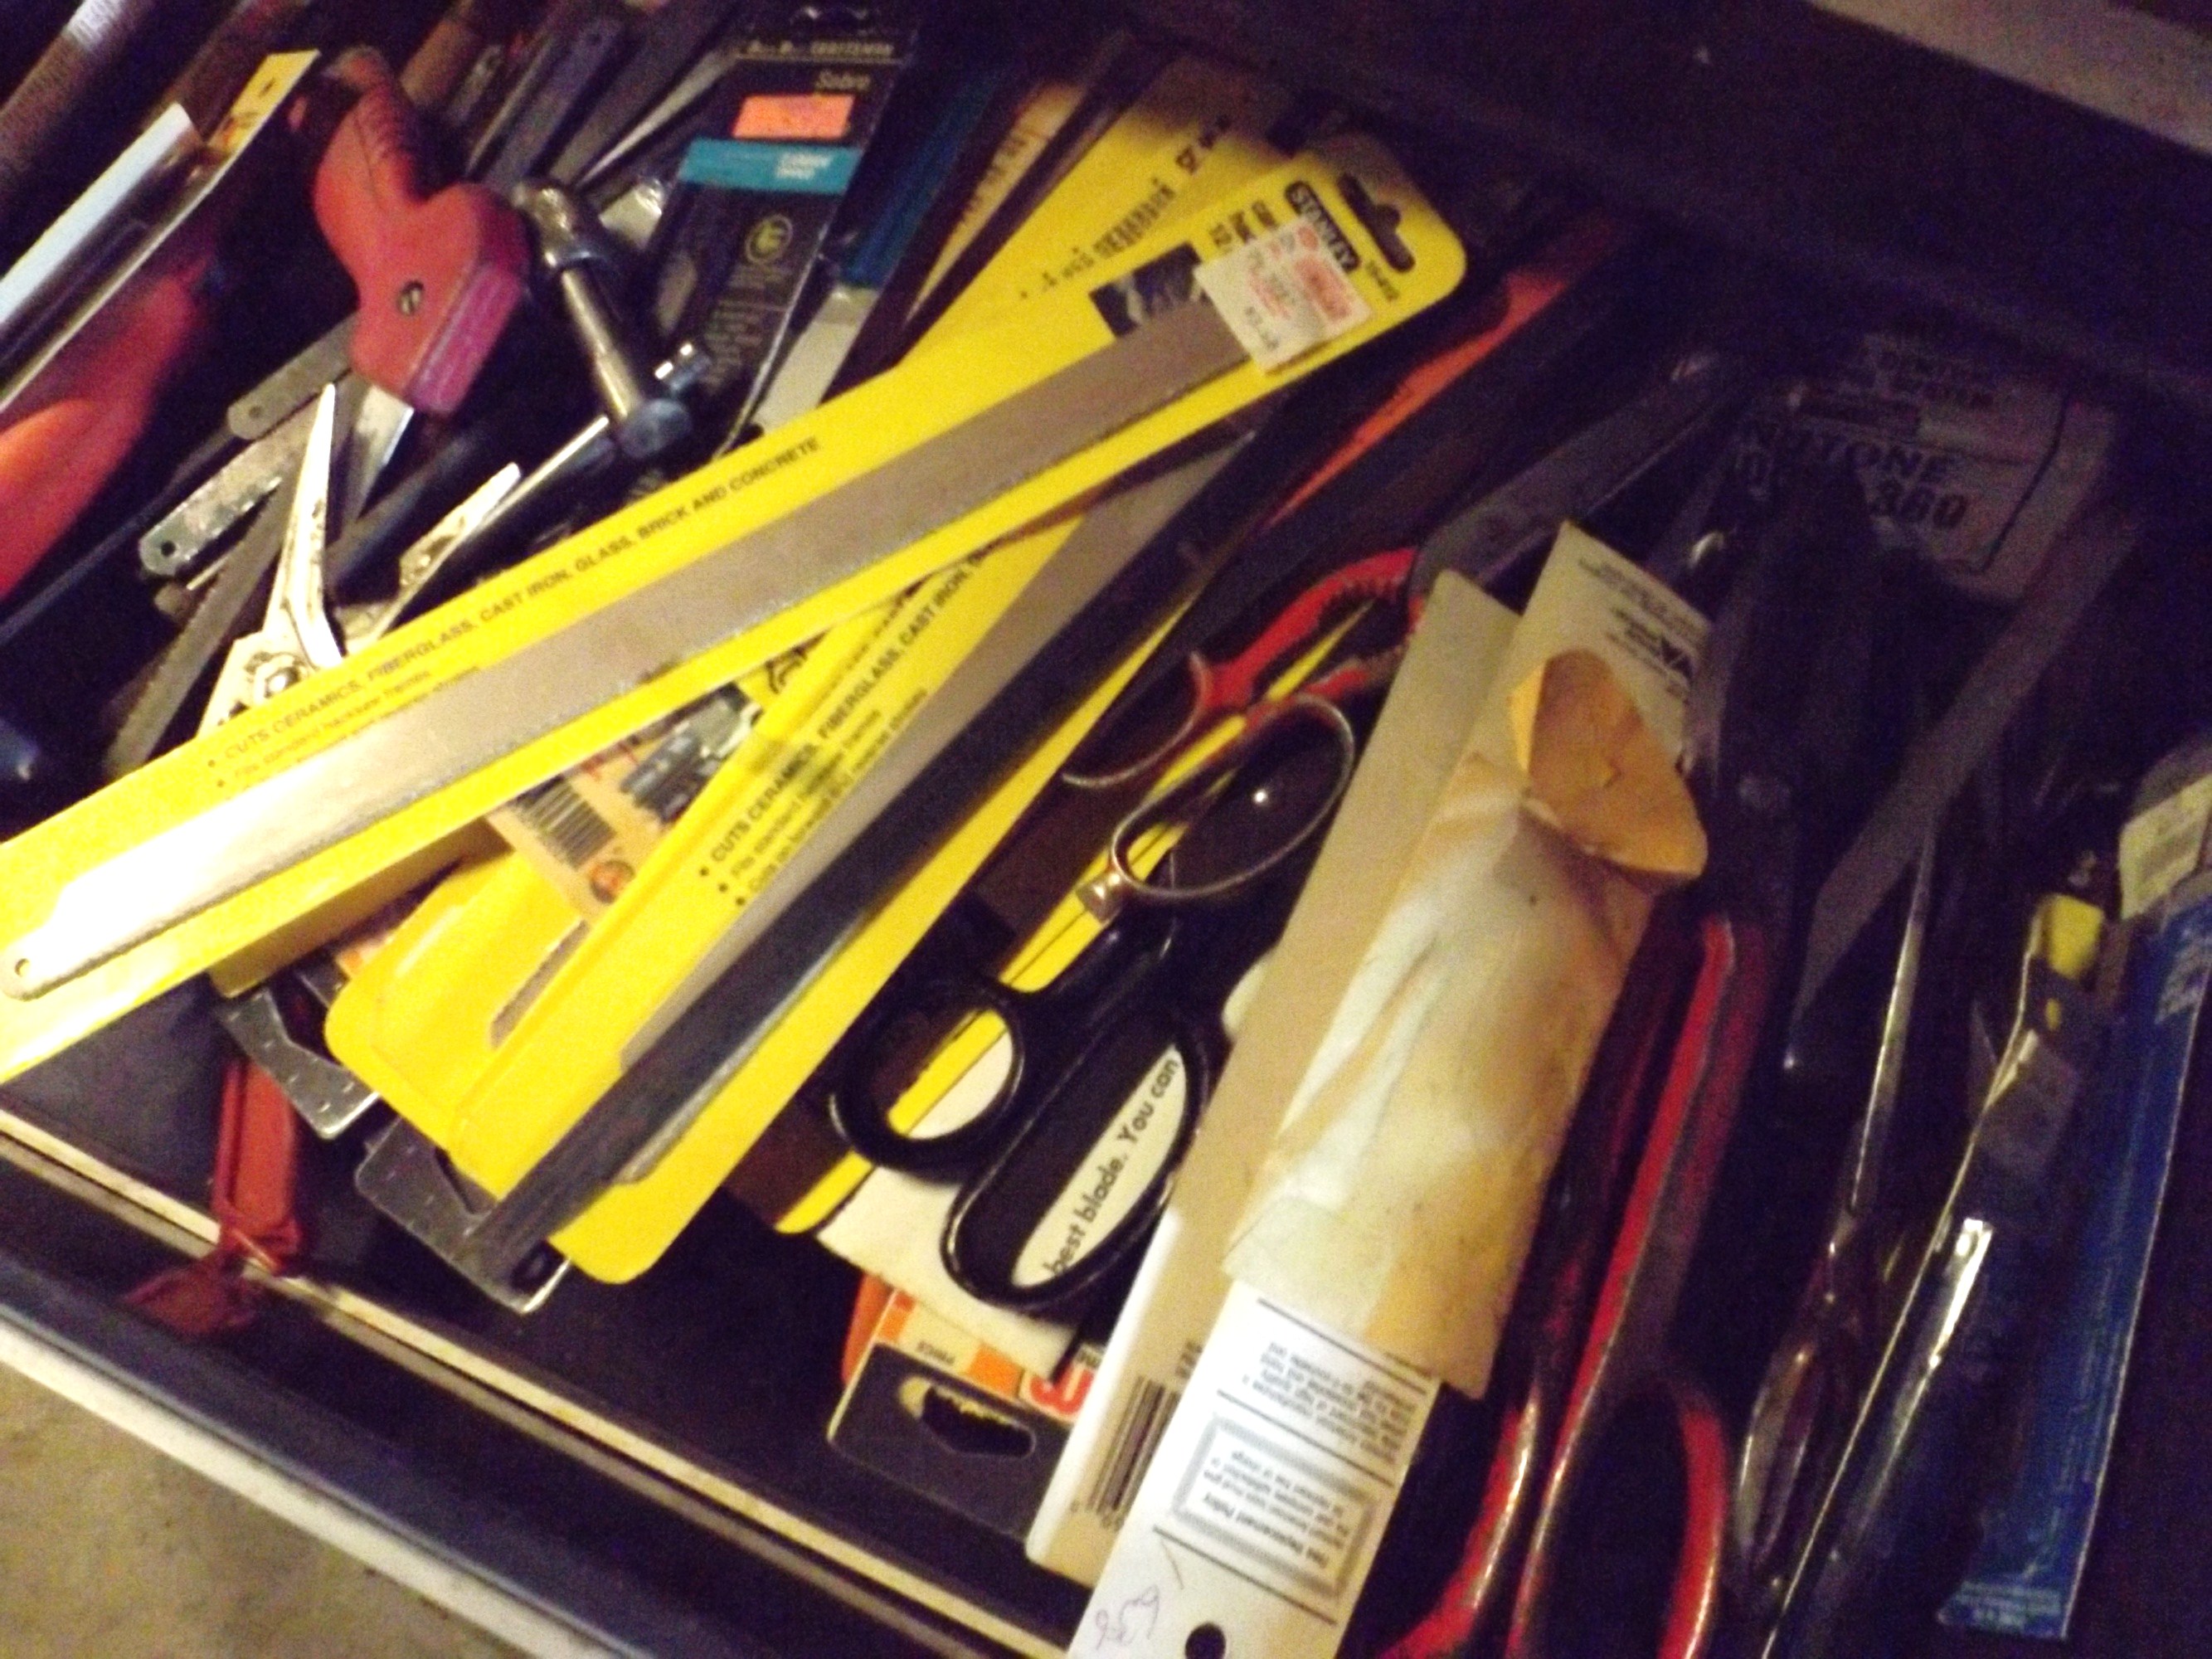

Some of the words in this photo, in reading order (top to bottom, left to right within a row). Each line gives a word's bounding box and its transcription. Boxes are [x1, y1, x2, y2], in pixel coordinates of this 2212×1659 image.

[1288, 184, 1356, 267] STANLEY
[222, 727, 270, 760] CUTS
[270, 676, 366, 736] CERAMICS,
[365, 616, 477, 683] FIBERGLASS,
[479, 591, 525, 624] CAST
[635, 504, 688, 539] BRICK
[690, 484, 727, 511] AND
[727, 435, 820, 493] CONCRETE
[711, 820, 751, 863] CUTS
[749, 743, 819, 821] CERAMICS,
[817, 647, 902, 737] FIBERGLASS,
[897, 605, 938, 645] CAST
[1043, 1225, 1087, 1278] best
[1078, 1154, 1130, 1224] blade.
[1117, 1102, 1156, 1146] You
[1151, 1058, 1180, 1101] can
